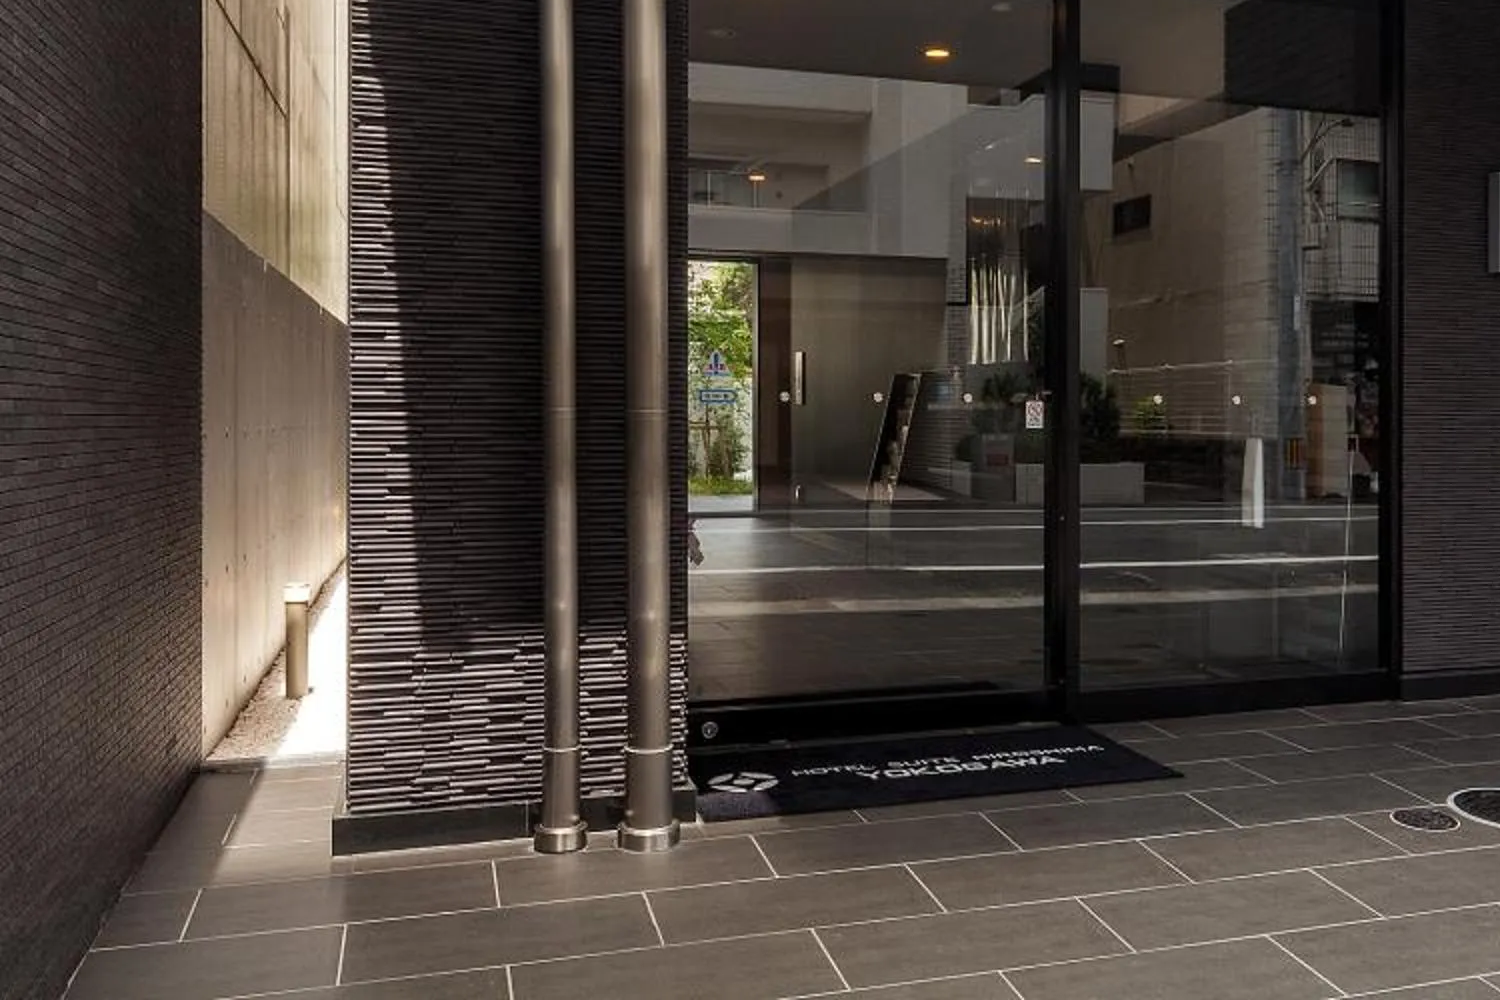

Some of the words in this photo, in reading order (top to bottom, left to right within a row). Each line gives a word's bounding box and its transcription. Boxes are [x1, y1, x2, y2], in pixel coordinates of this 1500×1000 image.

[791, 764, 876, 777] HOTEL
[887, 757, 960, 768] SUITE
[855, 755, 1066, 779] YOKOGAWA
